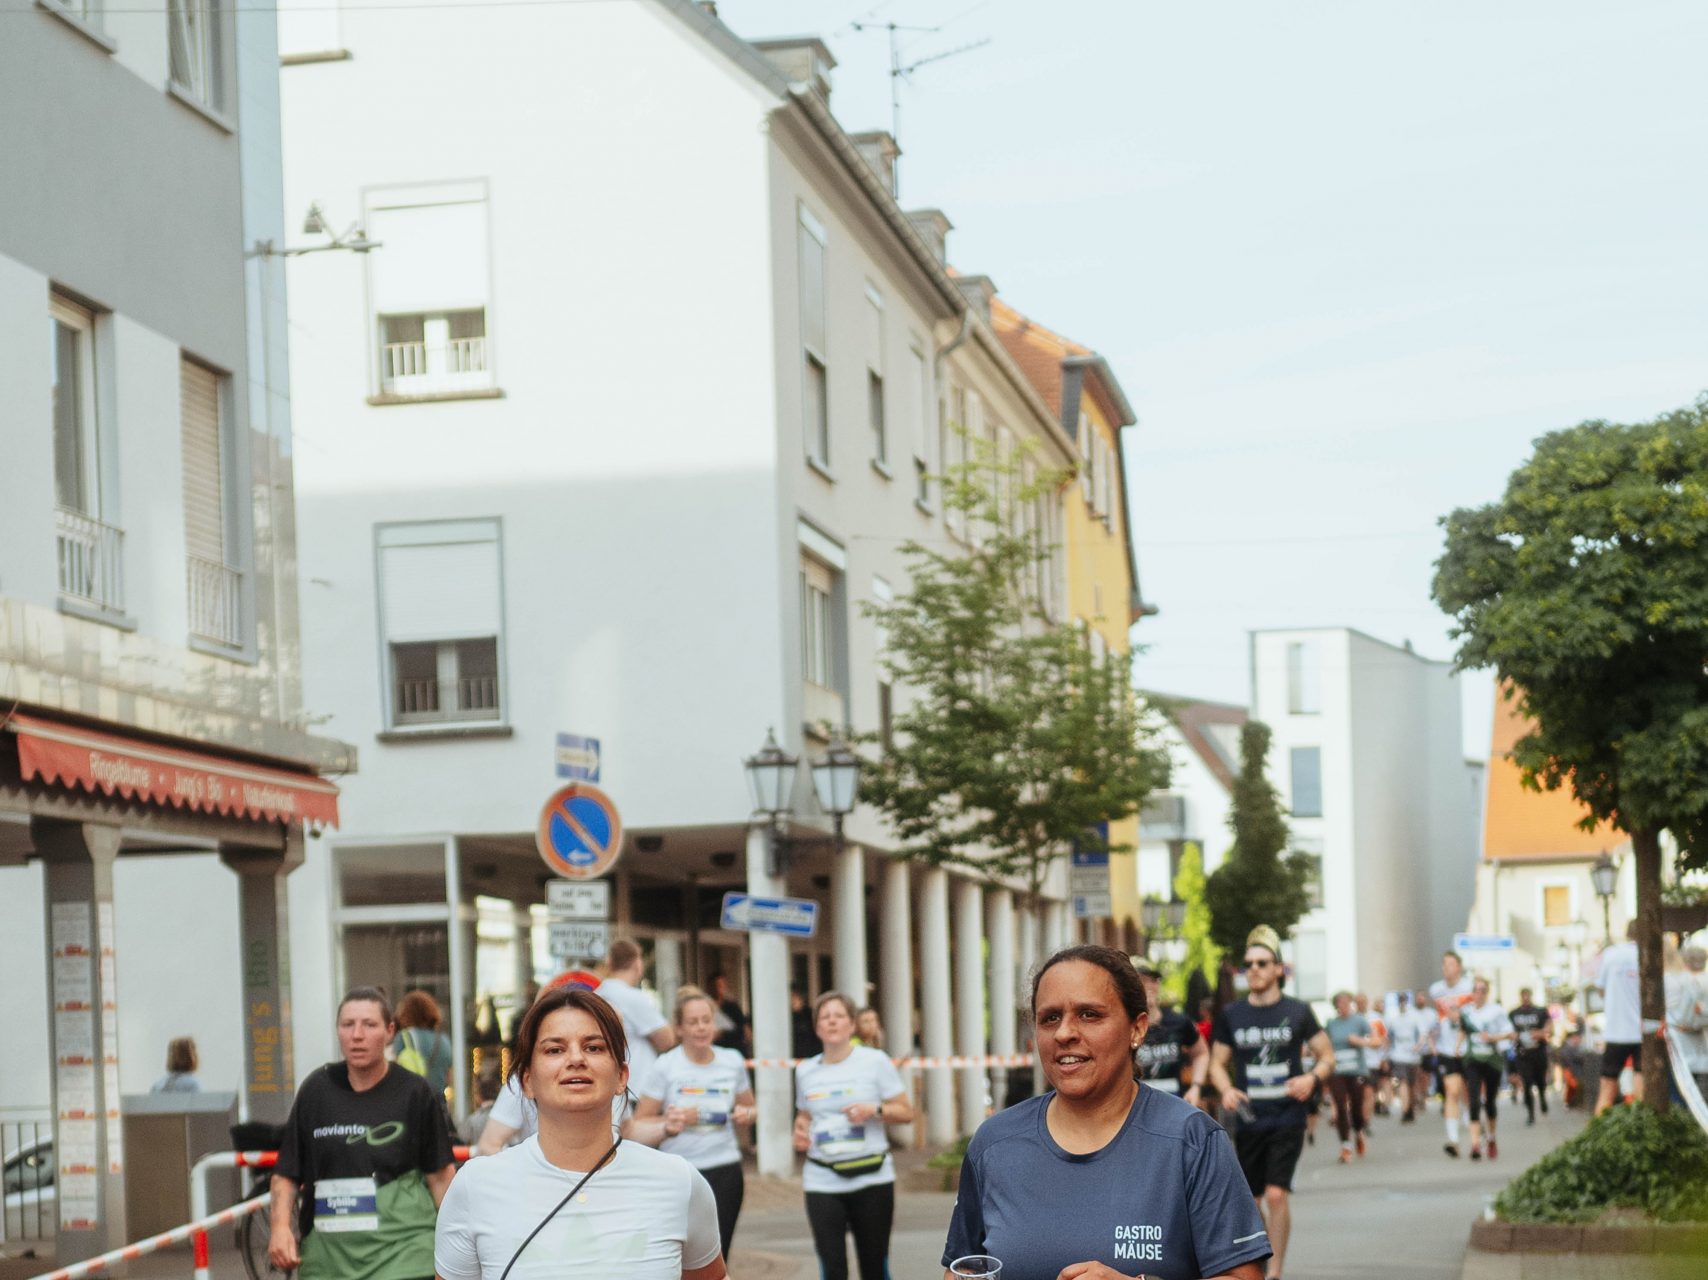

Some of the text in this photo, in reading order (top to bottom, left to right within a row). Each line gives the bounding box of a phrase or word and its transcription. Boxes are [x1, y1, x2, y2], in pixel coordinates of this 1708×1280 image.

[313, 1123, 366, 1139] movianto
[1115, 1225, 1162, 1240] GASTRO
[1114, 1240, 1163, 1260] MÄUSE
